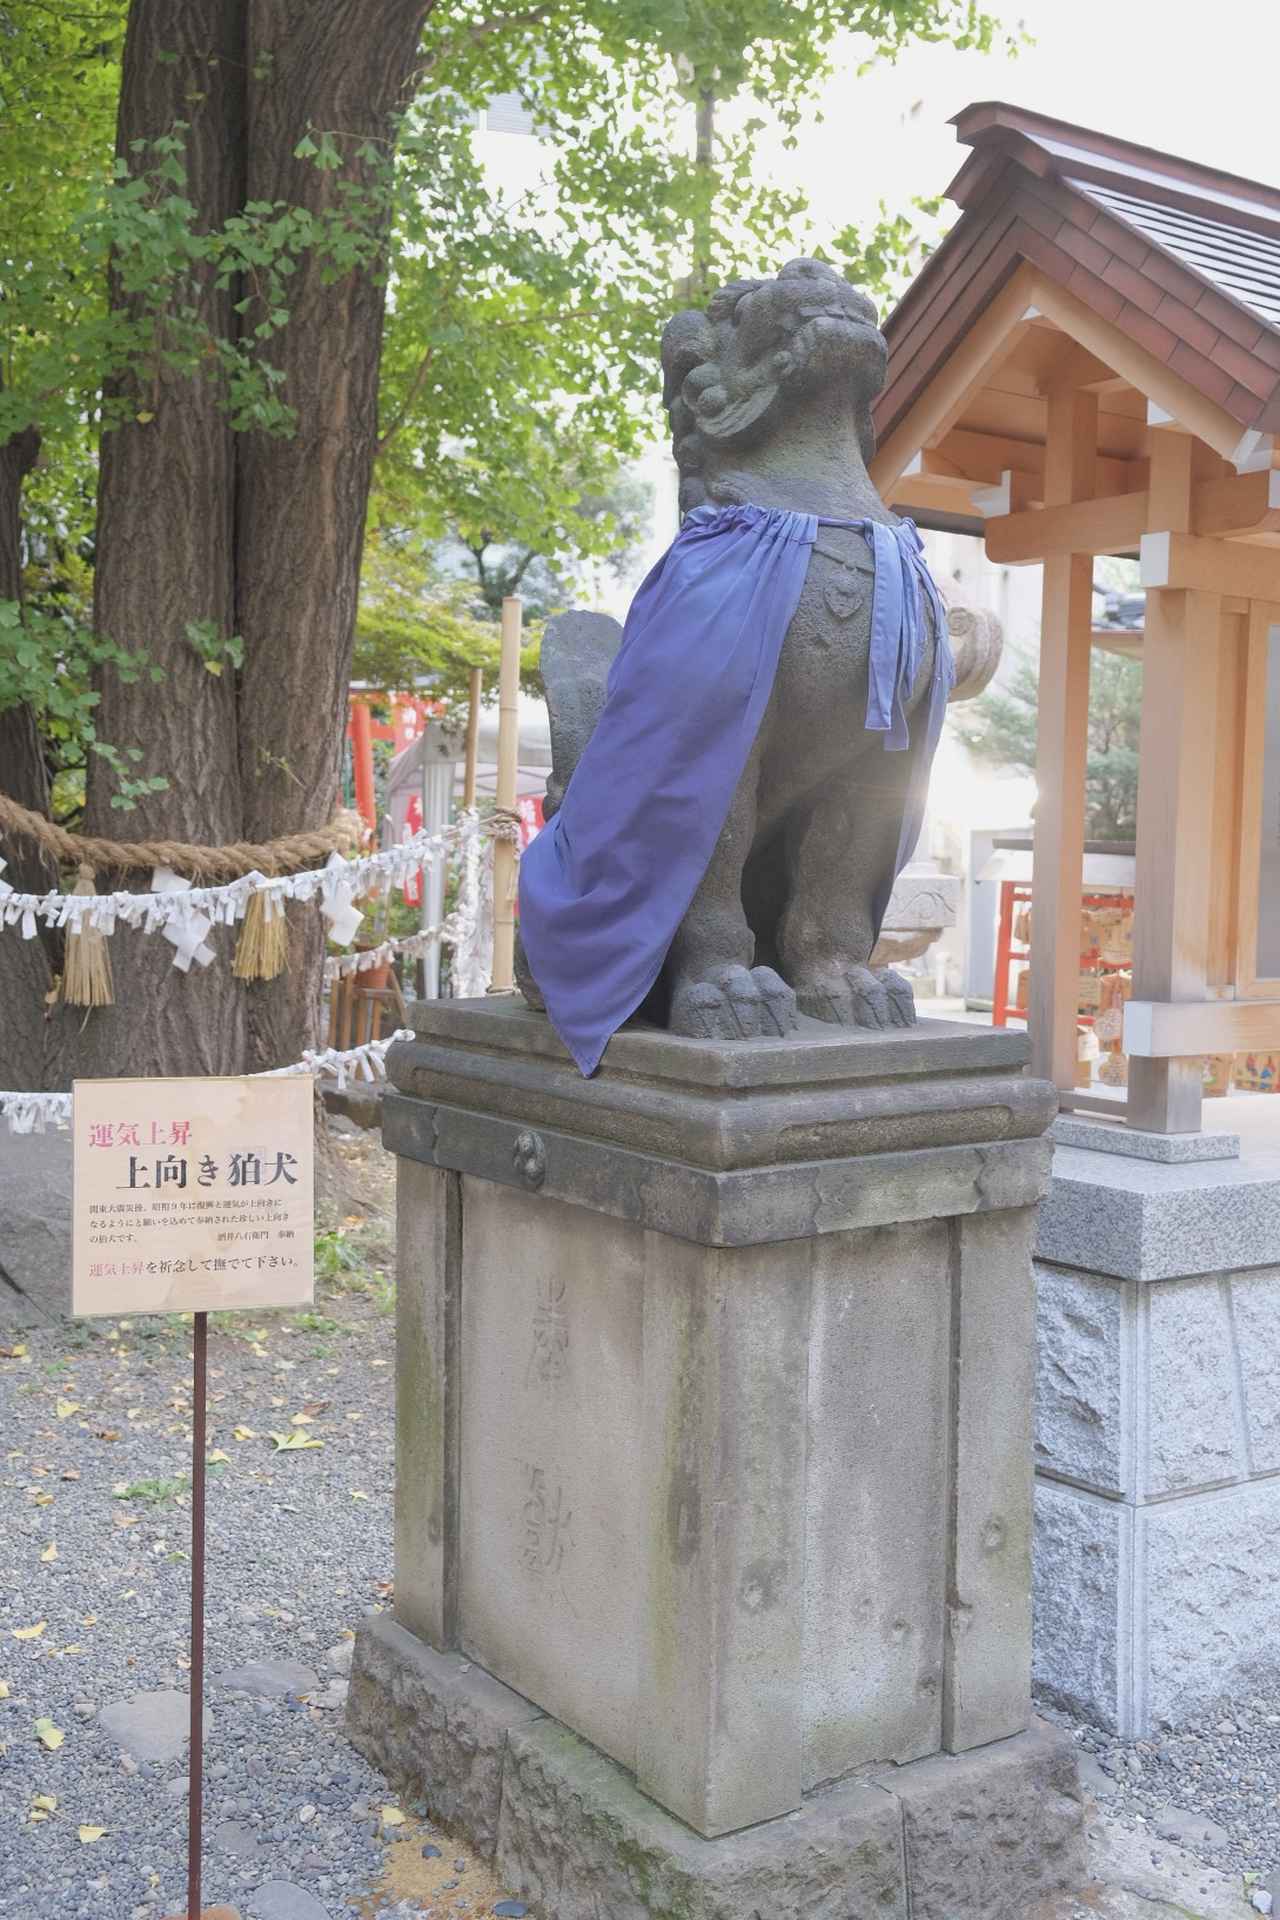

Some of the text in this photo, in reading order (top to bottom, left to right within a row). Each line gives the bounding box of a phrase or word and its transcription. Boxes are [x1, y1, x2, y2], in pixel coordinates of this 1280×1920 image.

[88, 1120, 192, 1147] 運気上昇
[116, 1151, 298, 1189] 上向き狛犬
[88, 1255, 299, 1277] 運気上昇を祈念して撫でて下さい。
